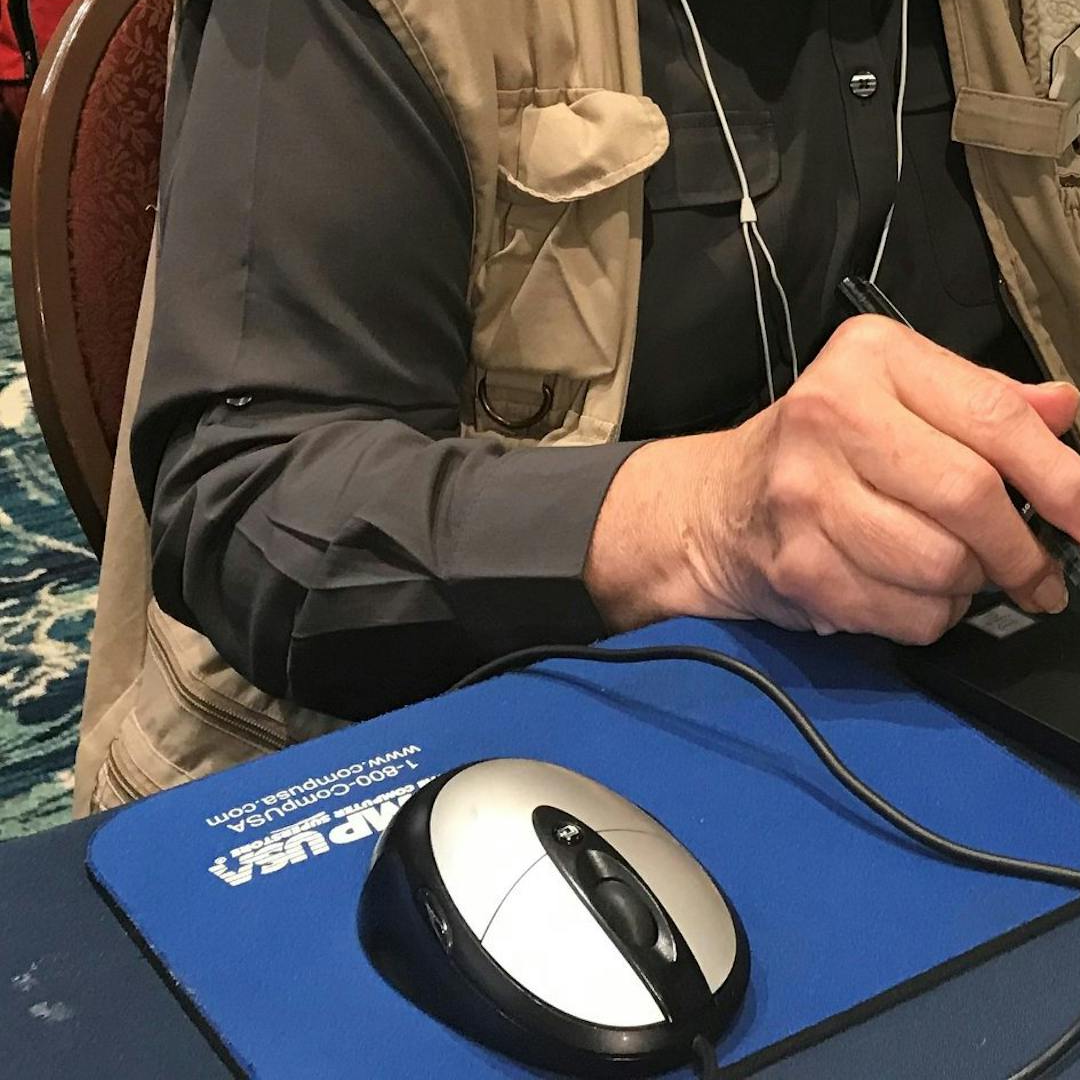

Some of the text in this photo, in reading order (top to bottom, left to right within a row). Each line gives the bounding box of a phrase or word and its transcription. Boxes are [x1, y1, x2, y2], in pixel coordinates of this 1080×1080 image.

[205, 744, 422, 826] www.compusa.com
[226, 759, 419, 833] 1-800-CompUSA
[229, 783, 416, 858] COMPUTER SUPERSTORE
[208, 792, 412, 887] MPUSA
